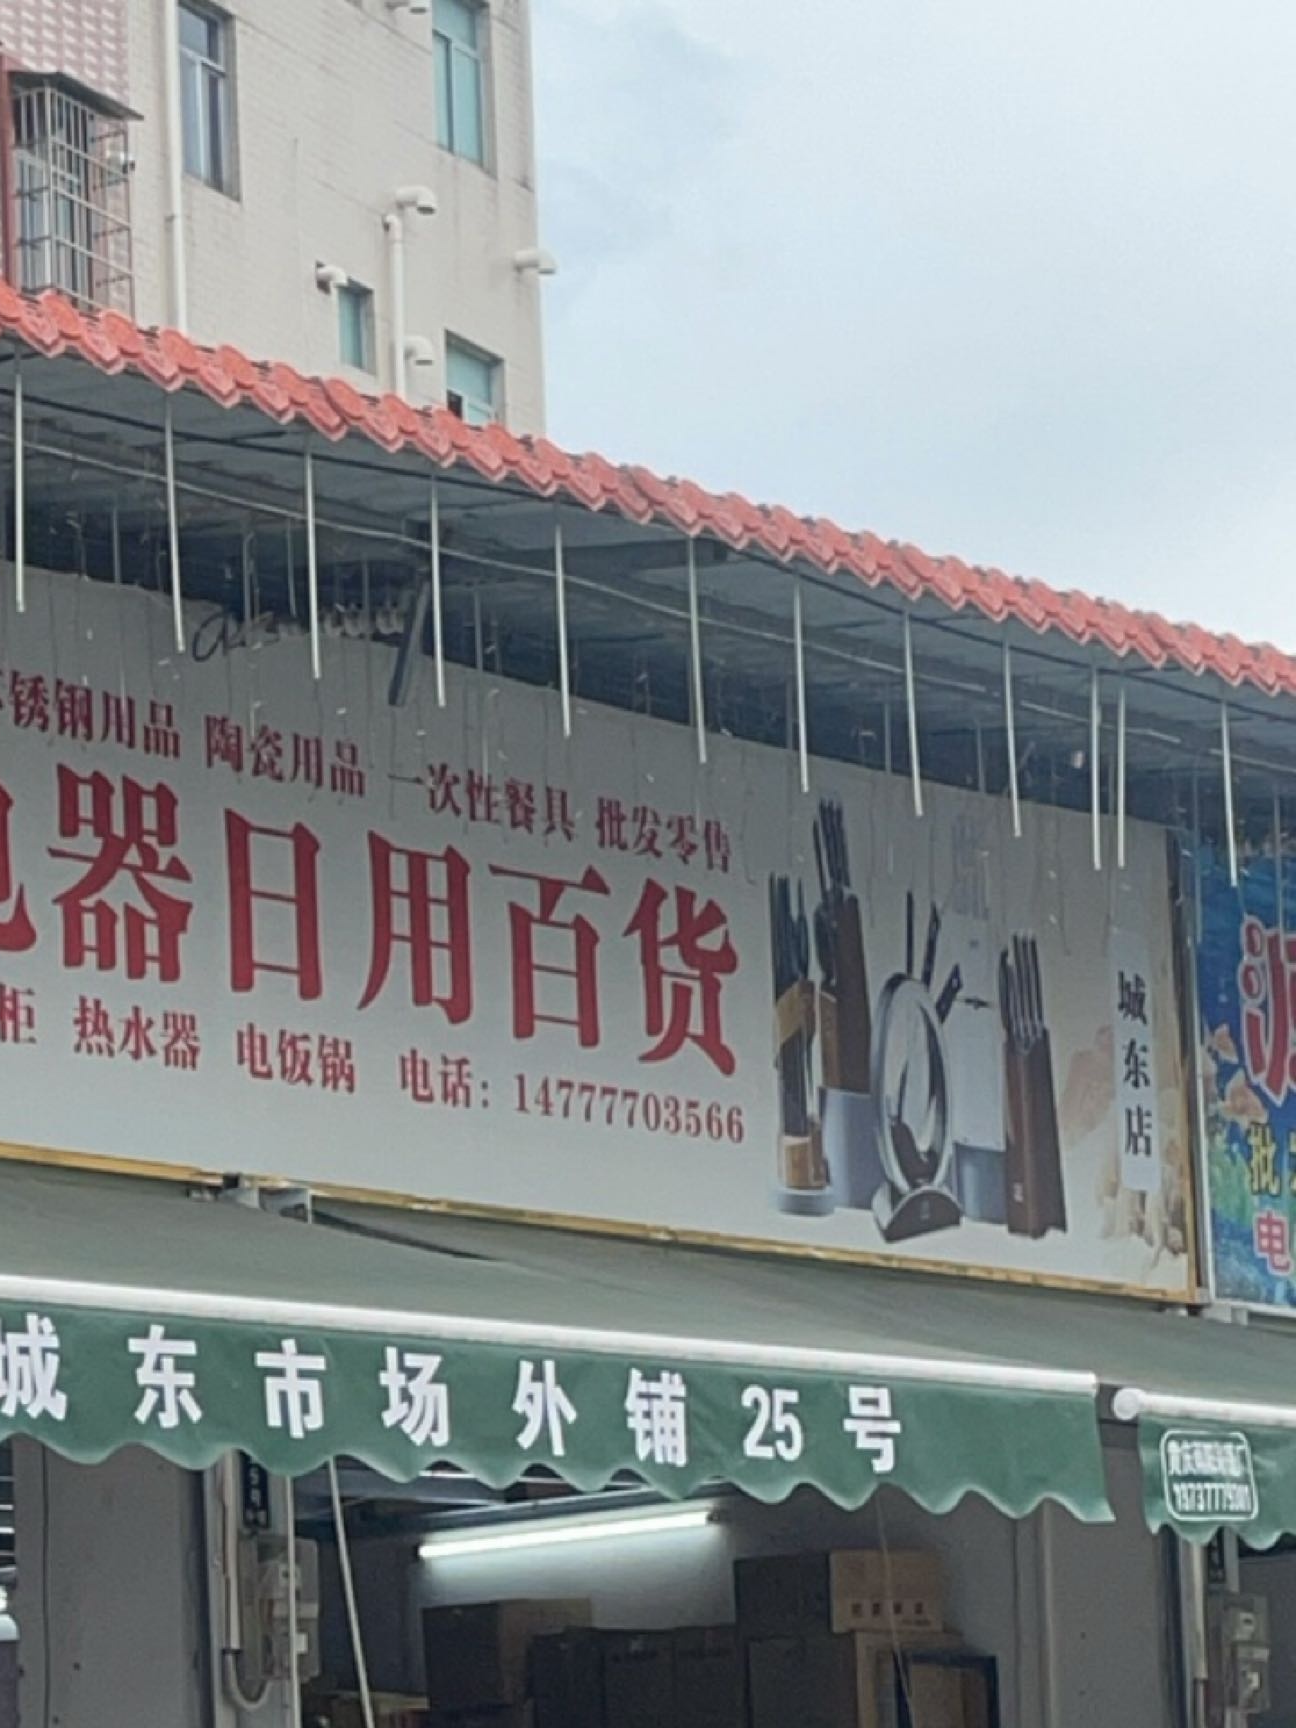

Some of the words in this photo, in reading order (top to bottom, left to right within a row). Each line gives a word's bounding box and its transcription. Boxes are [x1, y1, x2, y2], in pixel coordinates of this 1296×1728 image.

[205, 714, 366, 798] 陶瓷用品
[388, 763, 576, 843] 一次性餐具
[594, 797, 732, 874] 批发零售
[73, 995, 202, 1072] 热水器
[236, 1022, 358, 1094] 电饭锅
[1117, 969, 1154, 1158] 城东店
